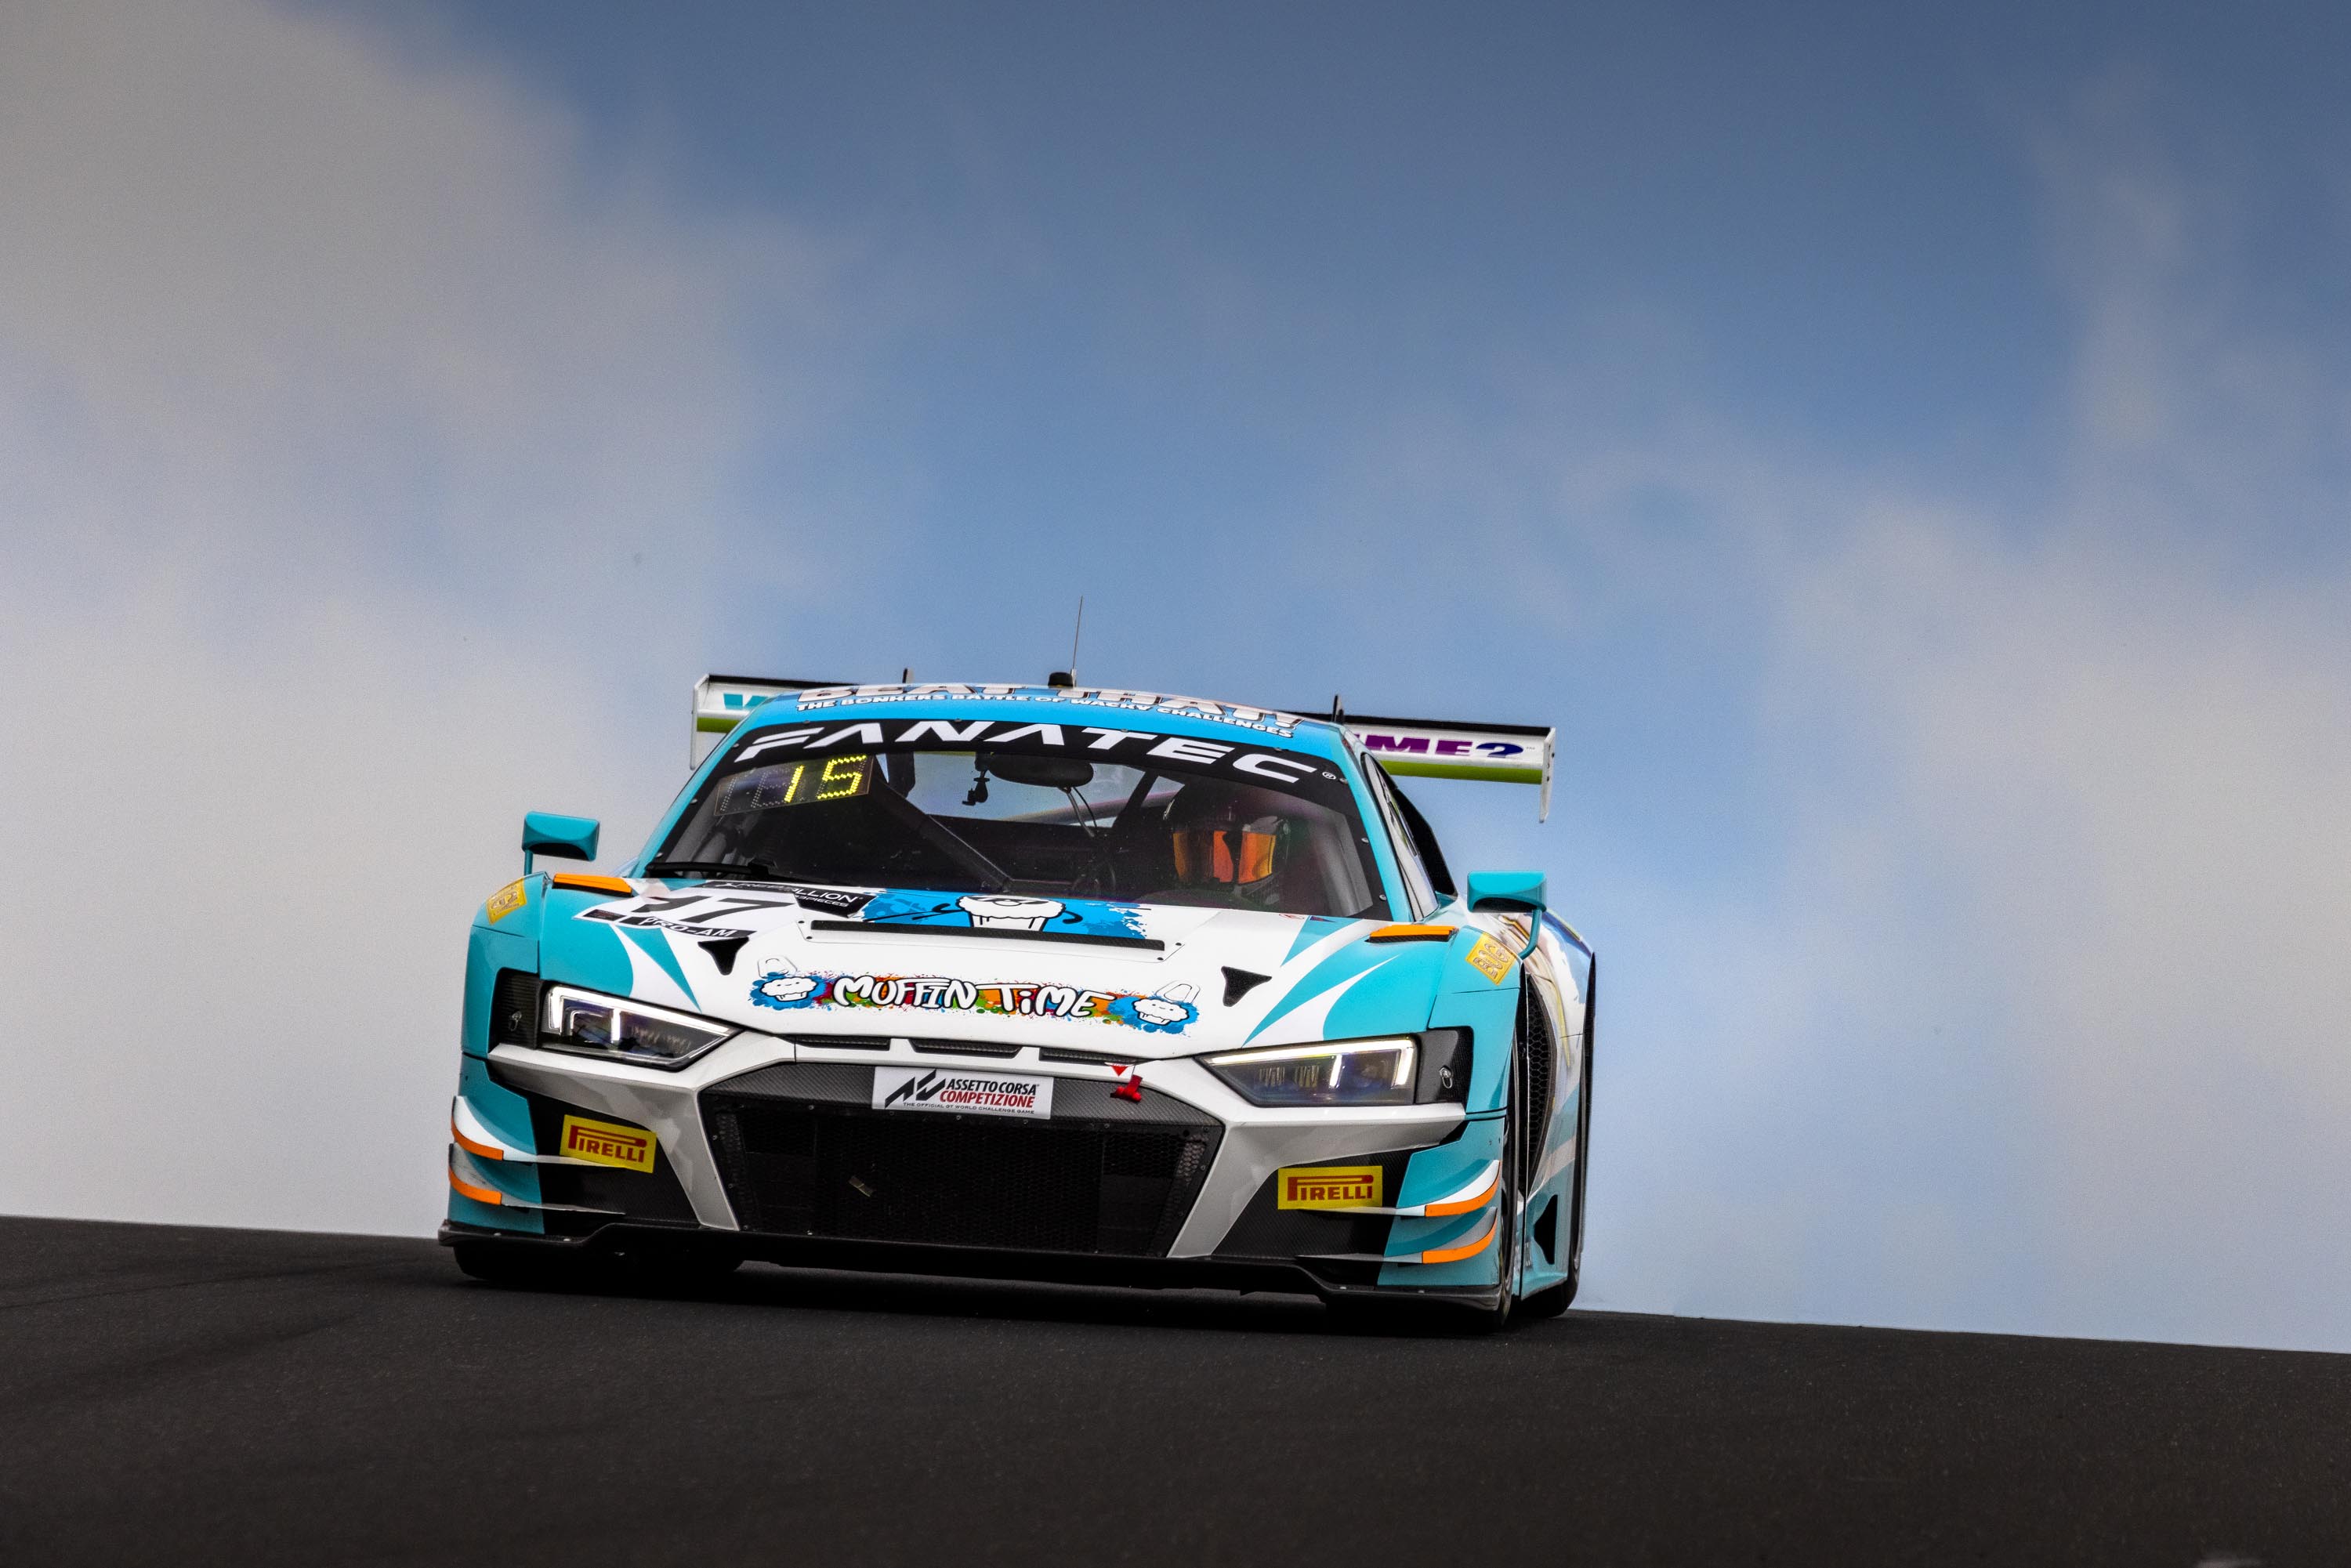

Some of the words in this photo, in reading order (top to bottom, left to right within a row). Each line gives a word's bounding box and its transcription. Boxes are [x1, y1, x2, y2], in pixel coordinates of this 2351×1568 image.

[796, 700, 836, 712] THE
[840, 694, 946, 705] BONKERS
[951, 693, 1031, 702] BATTLE
[1070, 698, 1154, 711] WACKY
[1156, 708, 1293, 738] CHALLENGES
[734, 720, 1317, 783] FANATEC
[784, 755, 867, 803] 15
[639, 917, 739, 937] PRO-AM
[833, 975, 978, 1010] MUFFIN
[940, 1090, 1035, 1108] COMPETIZIONE
[947, 1078, 998, 1093] ASSETTO
[998, 1081, 1037, 1095] CORSA
[568, 1124, 647, 1163] PIRELLI
[1287, 1174, 1374, 1201] PIRELLI
